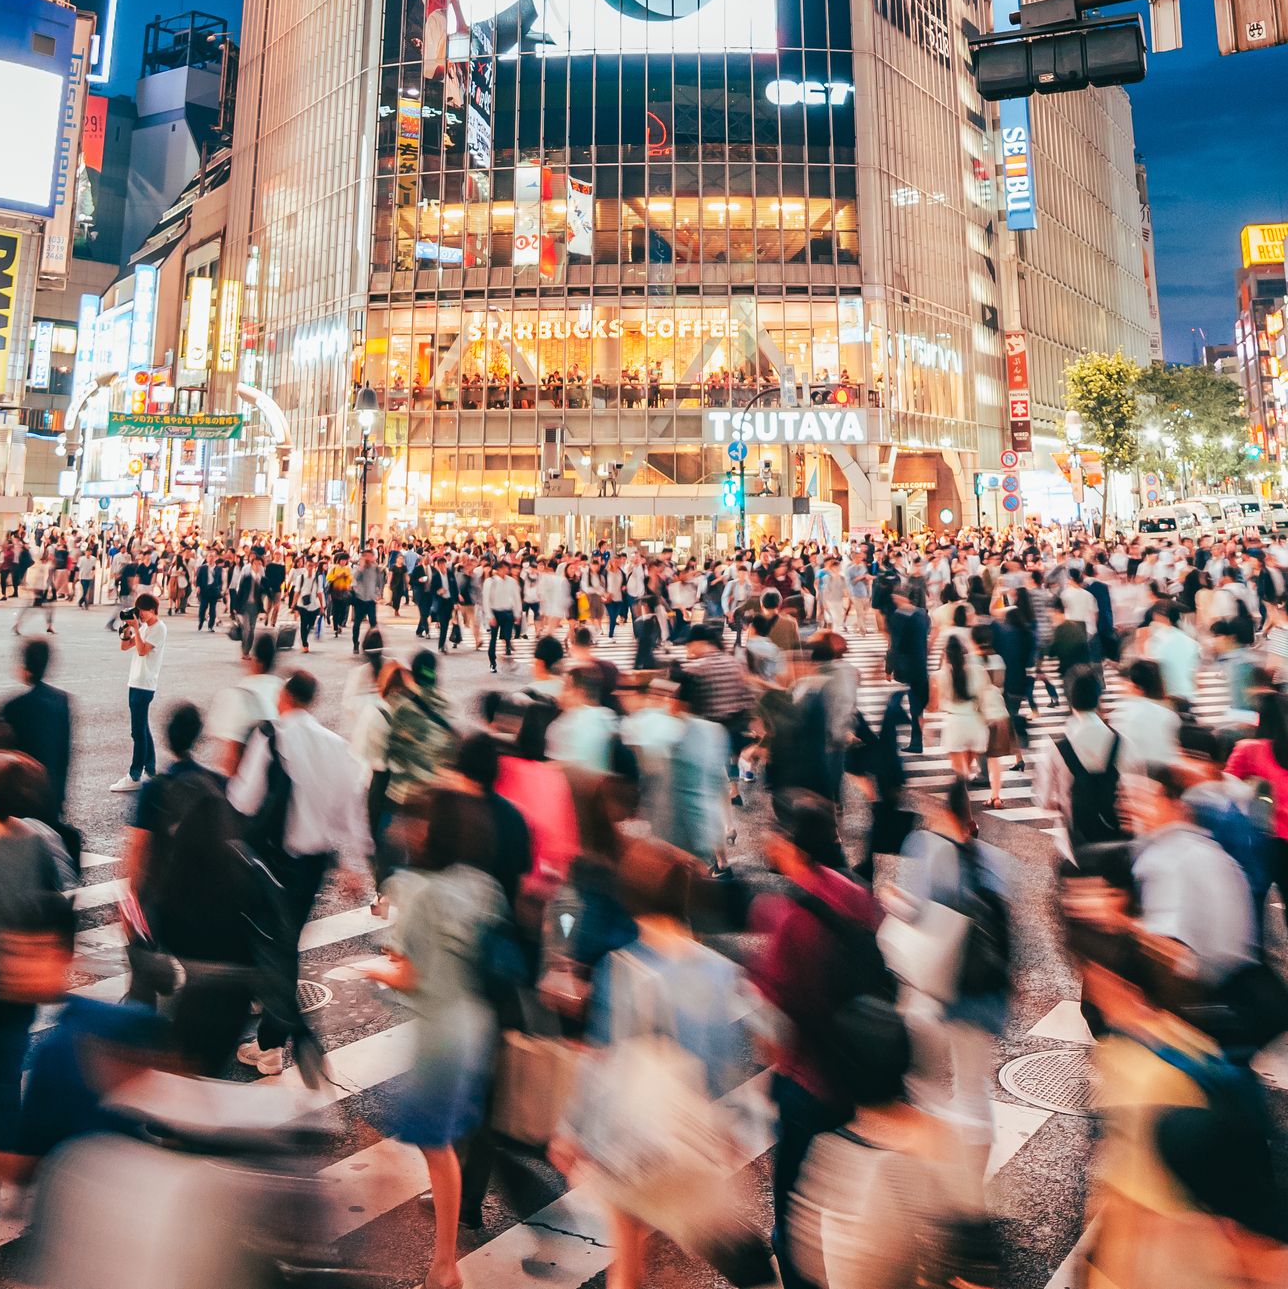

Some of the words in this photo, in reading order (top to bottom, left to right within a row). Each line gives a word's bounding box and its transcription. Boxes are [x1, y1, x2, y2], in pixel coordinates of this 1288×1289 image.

[1003, 126, 1032, 217] SEIBU
[467, 317, 625, 342] STARBUCKS
[640, 318, 741, 339] COFFEE
[1012, 401, 1027, 417] 本
[708, 411, 865, 443] TSUTAYA
